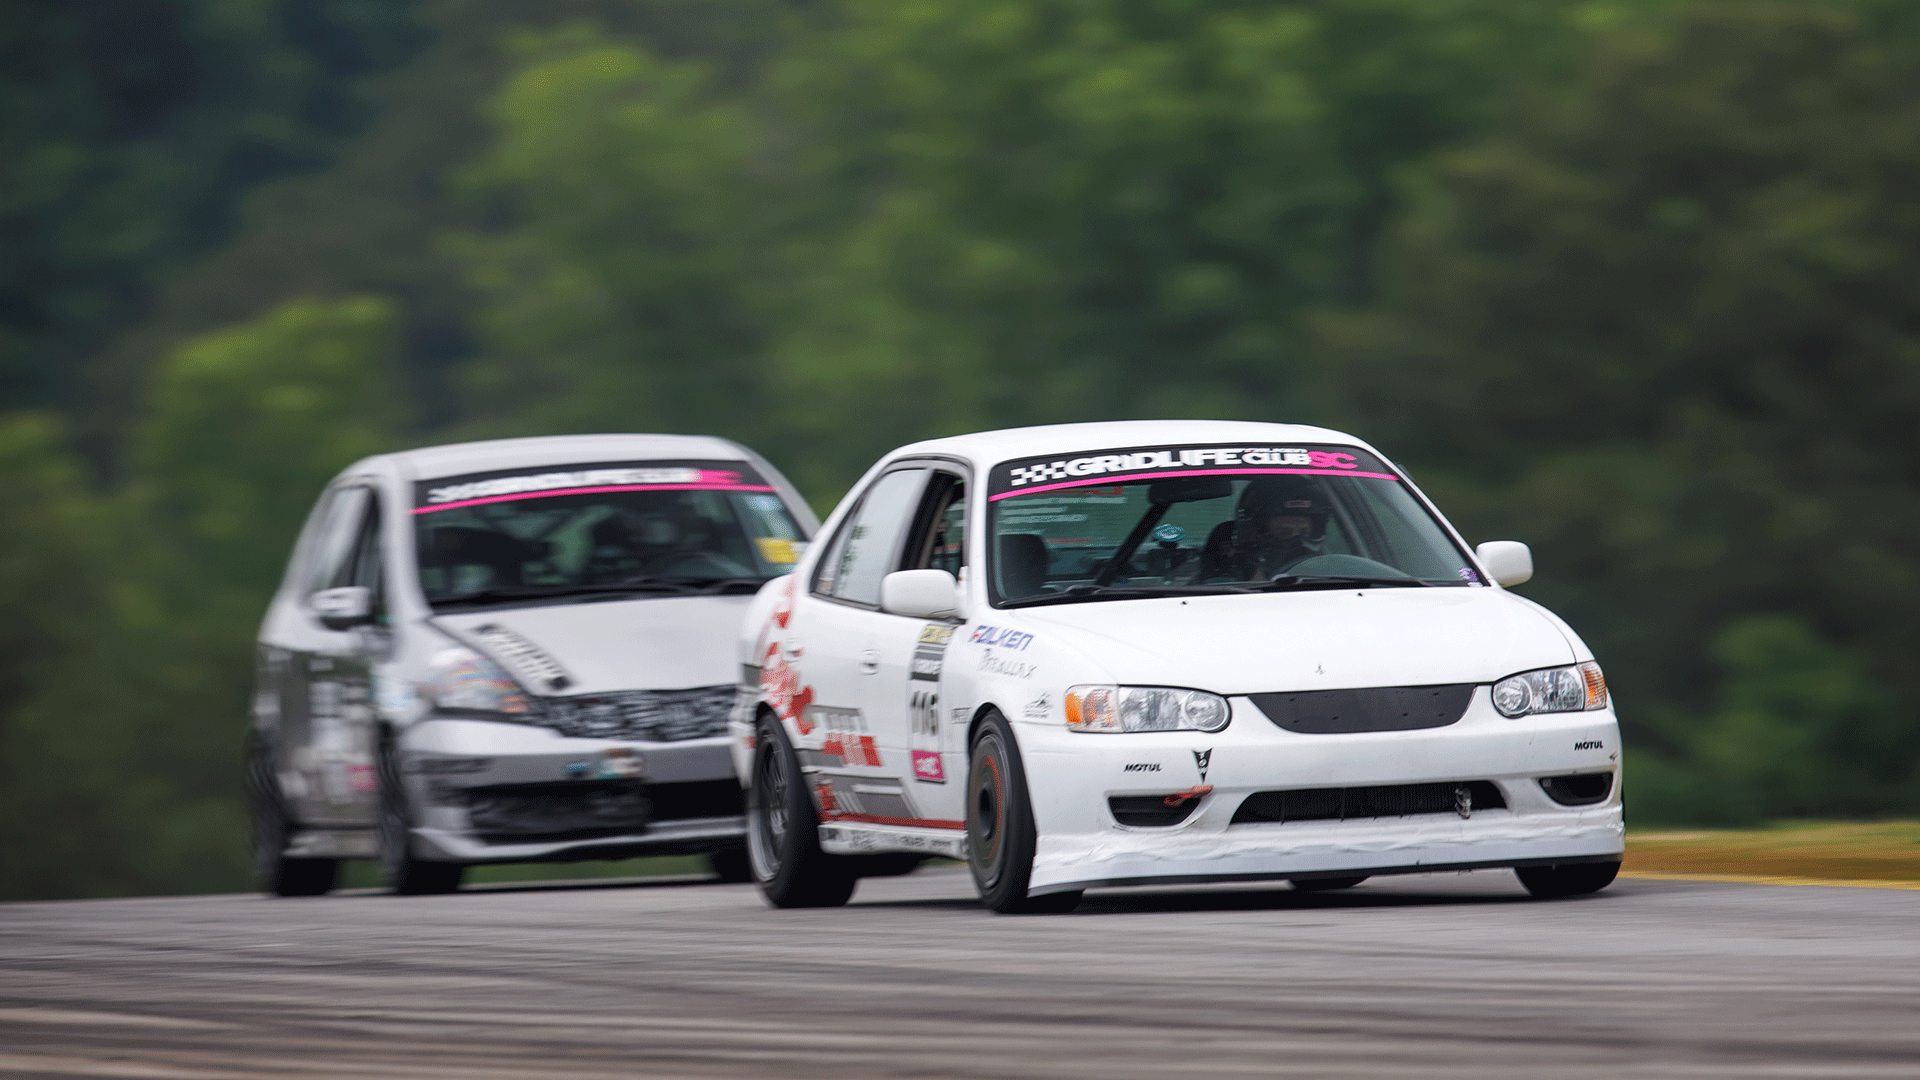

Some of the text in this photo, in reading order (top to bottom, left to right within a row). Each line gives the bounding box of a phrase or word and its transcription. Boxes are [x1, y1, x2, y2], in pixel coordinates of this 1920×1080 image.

[1063, 449, 1243, 476] GRIDLIFE
[968, 625, 1034, 651] FALKEN
[1573, 740, 1603, 750] MOTUL
[1123, 763, 1162, 772] MOTUL
